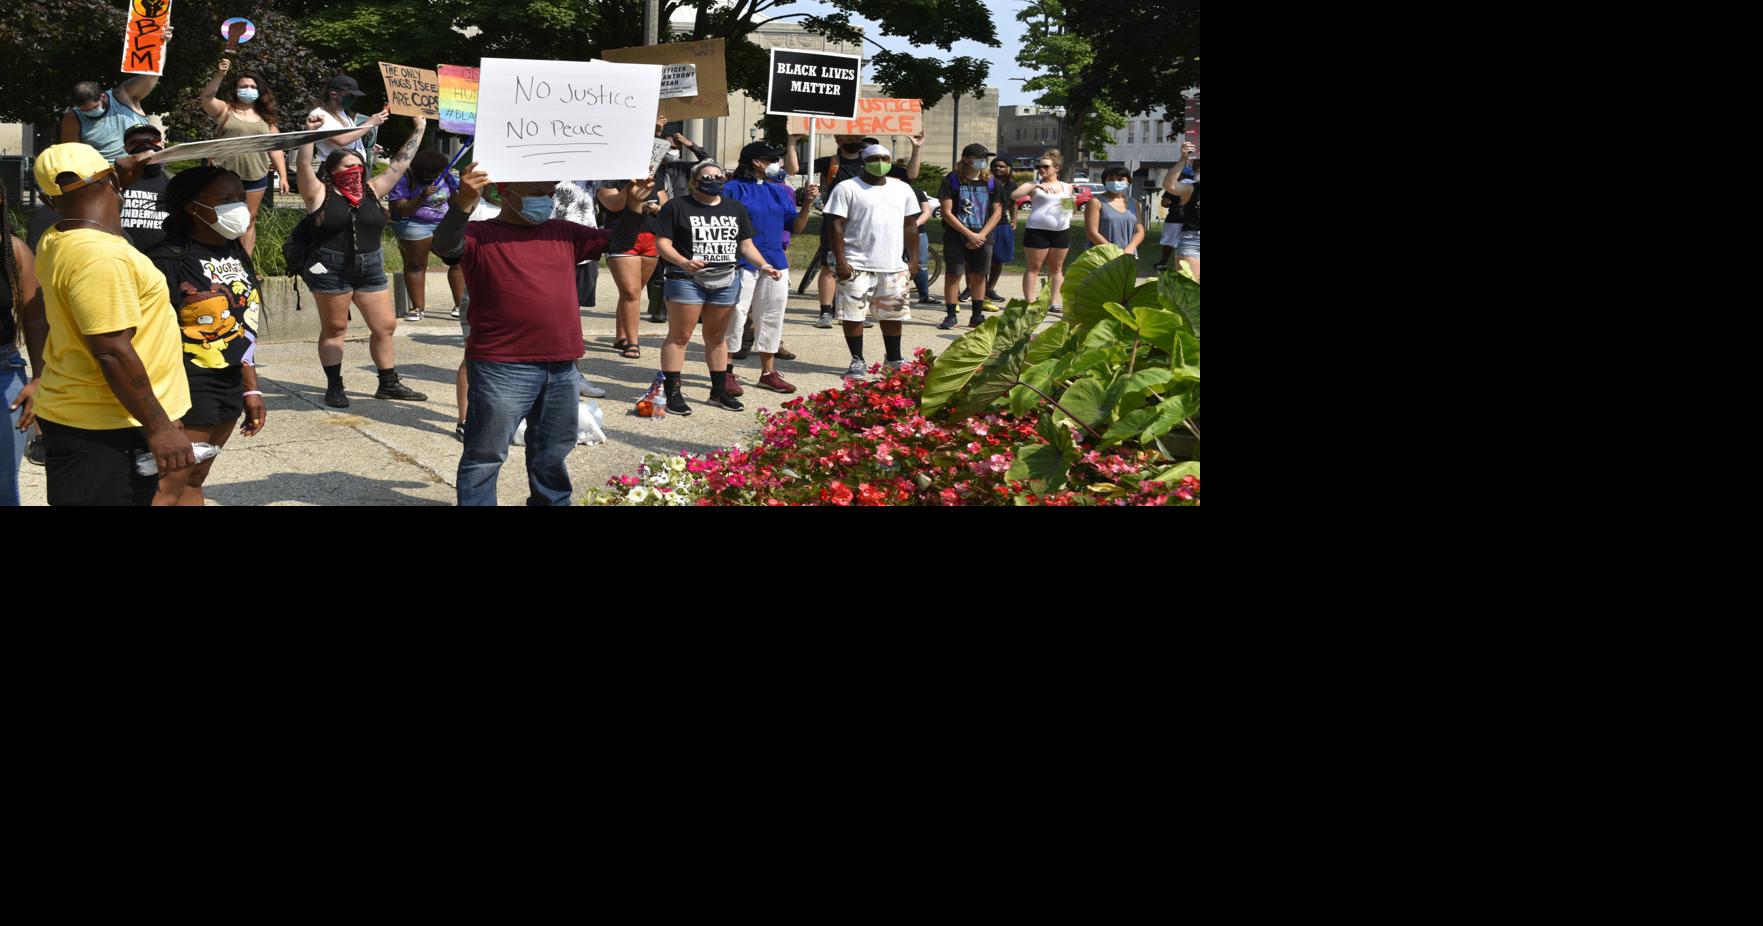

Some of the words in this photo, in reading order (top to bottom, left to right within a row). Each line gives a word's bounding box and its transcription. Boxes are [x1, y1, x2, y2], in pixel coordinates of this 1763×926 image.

[132, 19, 160, 70] BLM
[382, 64, 399, 76] THE
[401, 68, 420, 79] ONLY
[662, 72, 695, 80] ANTHONY
[777, 62, 817, 77] BLACK
[821, 66, 855, 81] LIVES
[385, 76, 411, 89] THUGS
[414, 80, 418, 91] I
[420, 82, 438, 92] SEE
[790, 80, 841, 96] MATTER
[392, 91, 411, 106] ARE
[454, 88, 477, 100] HU
[515, 75, 551, 104] NO
[560, 83, 637, 109] Justice
[858, 99, 921, 113] USTICE
[445, 108, 477, 121] #BLA
[506, 118, 539, 139] NO
[551, 119, 604, 137] Peace
[847, 115, 914, 134] PEACE
[124, 190, 158, 201] LATANT
[124, 199, 156, 210] ACISM
[689, 215, 738, 227] BLACK
[695, 227, 737, 241] LIVES
[693, 242, 737, 254] MATTER
